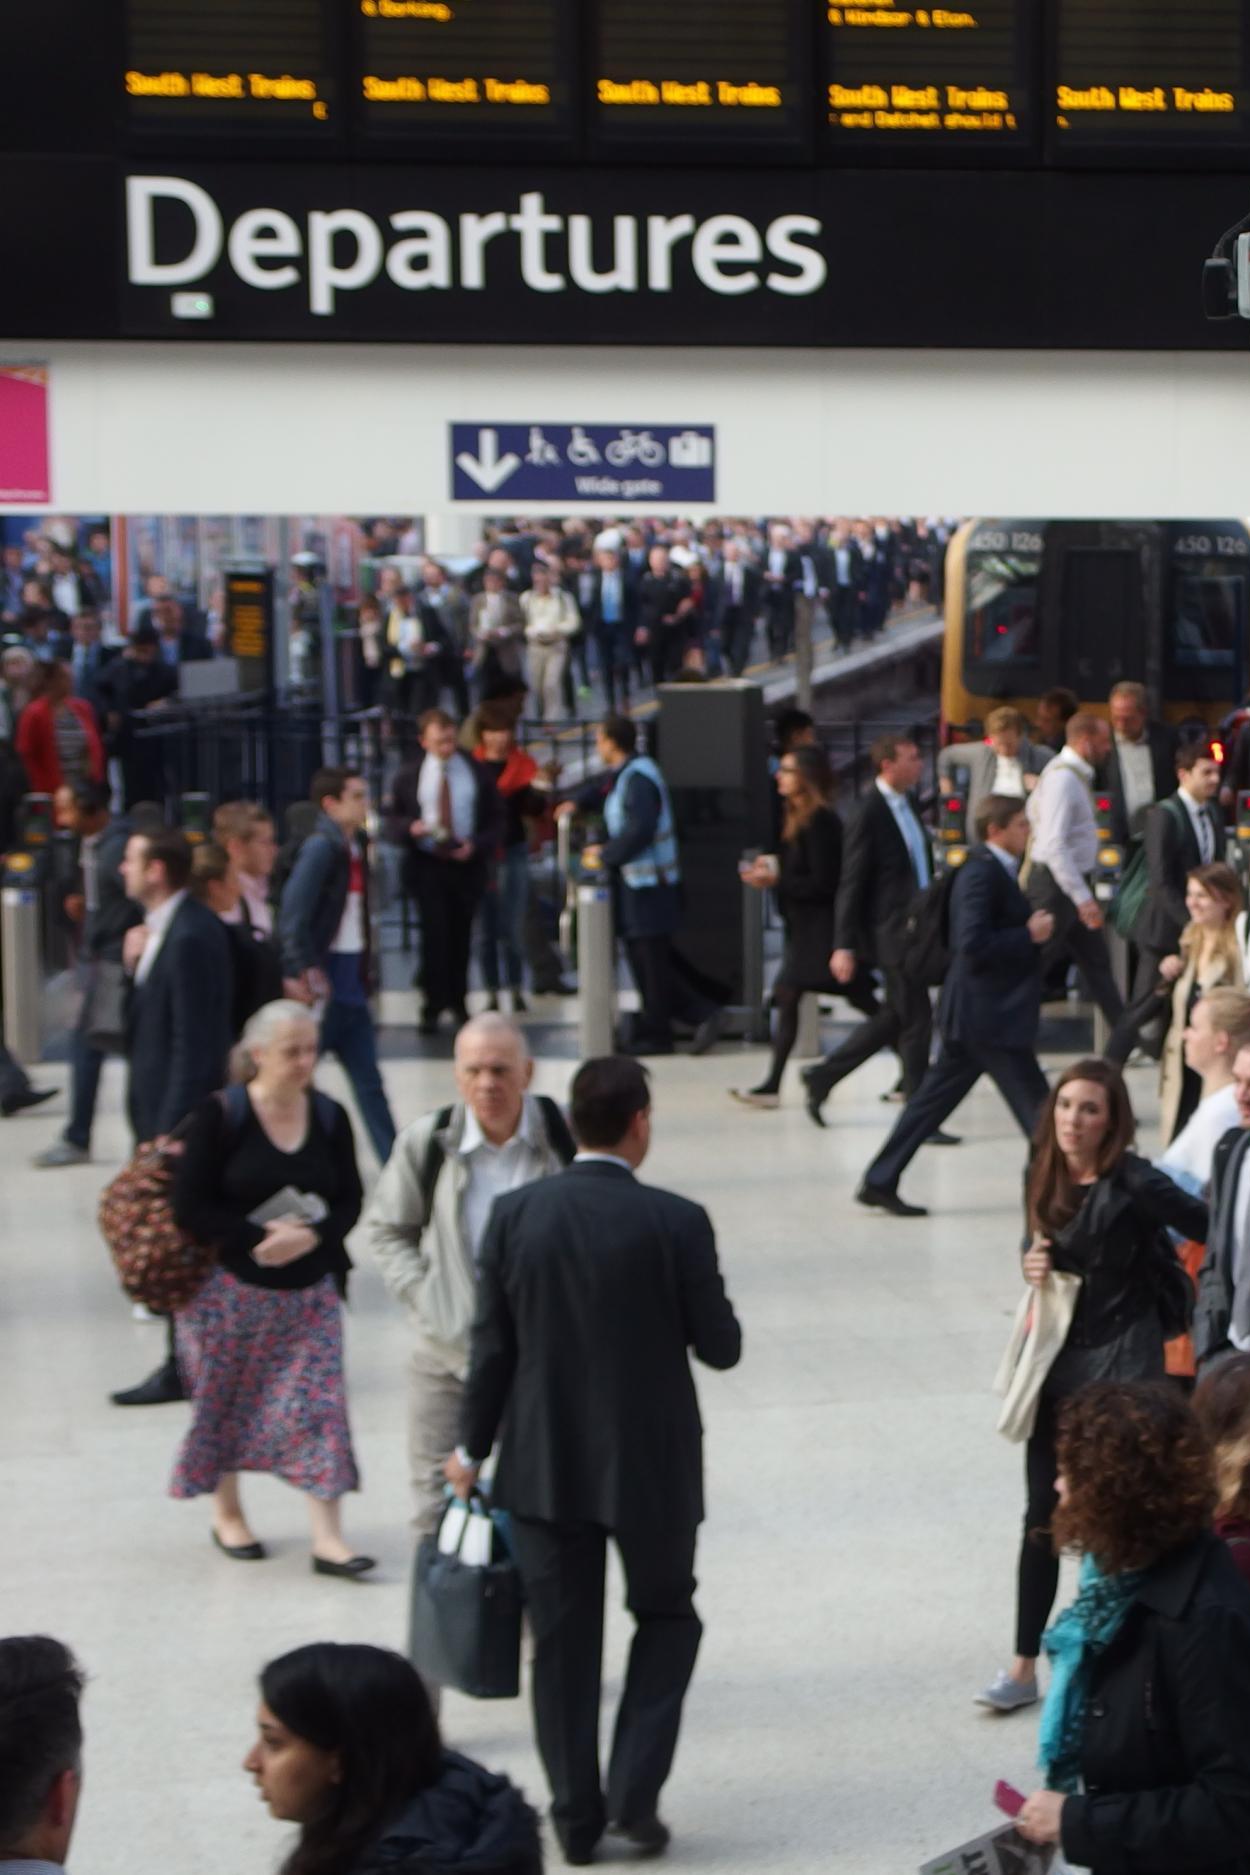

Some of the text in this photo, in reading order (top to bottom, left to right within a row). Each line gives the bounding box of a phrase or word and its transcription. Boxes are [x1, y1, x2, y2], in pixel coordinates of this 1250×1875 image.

[828, 84, 1009, 111] South West Trains
[1056, 85, 1234, 112] South West Trains
[125, 175, 827, 315] Departures
[1011, 533, 1044, 550] 126
[1216, 537, 1249, 554] 126
